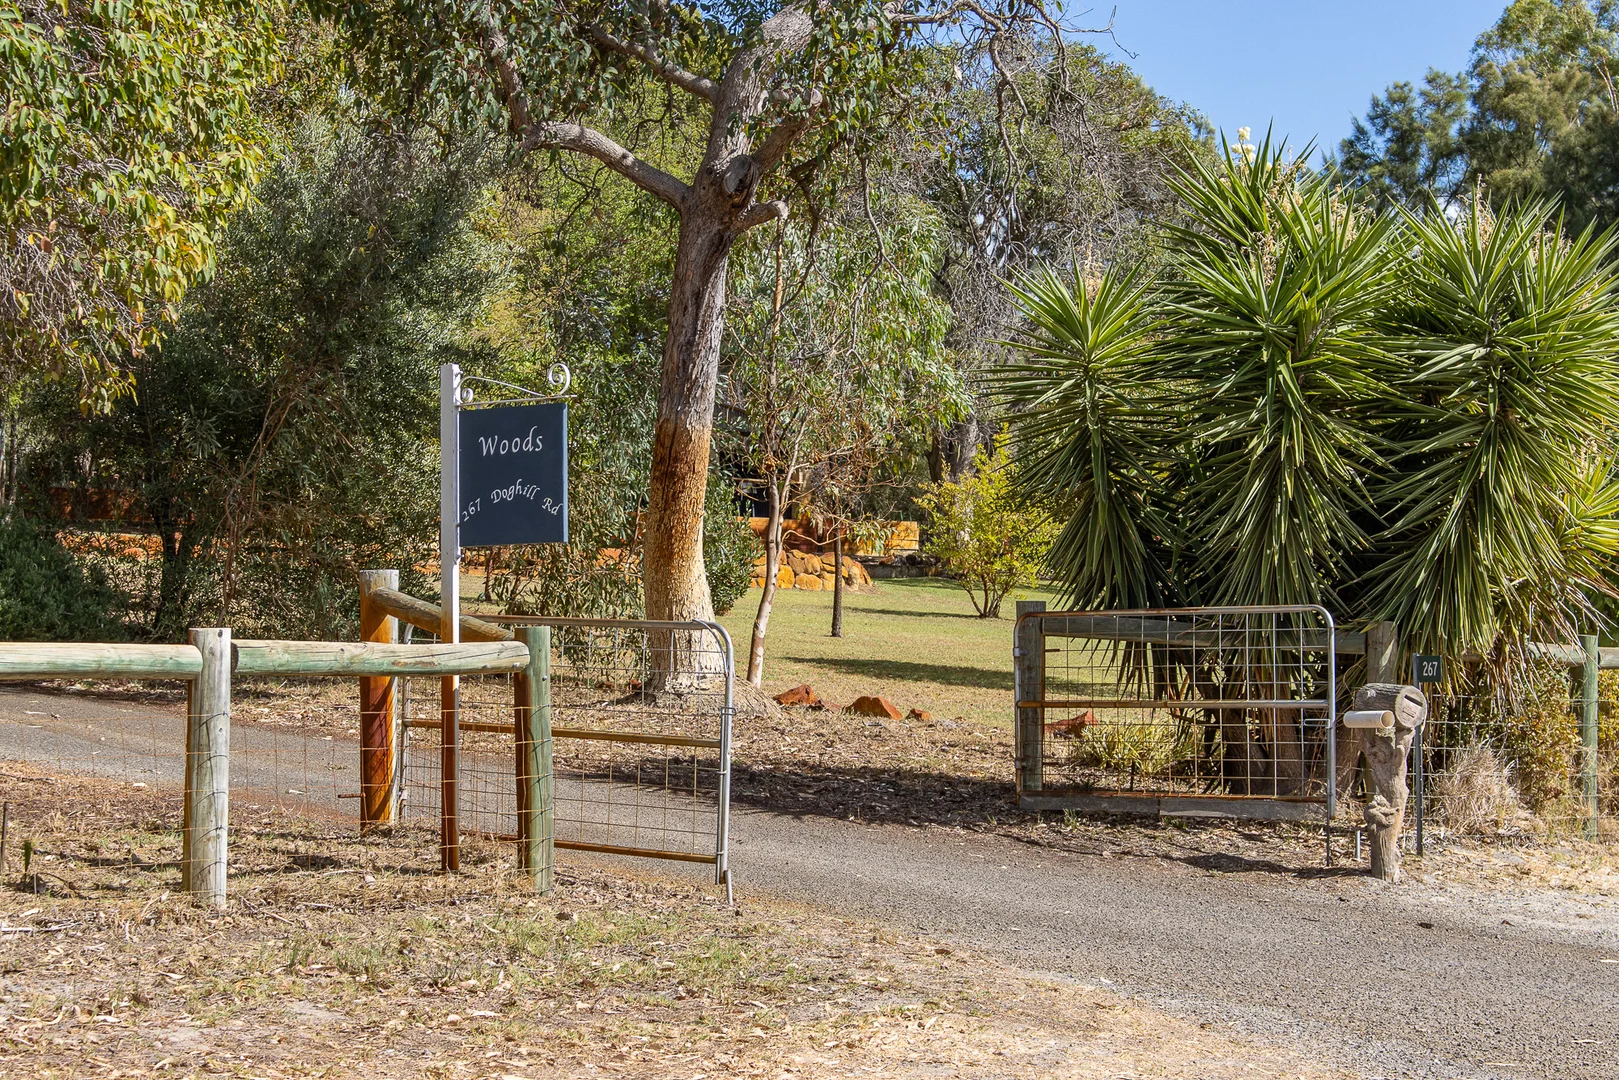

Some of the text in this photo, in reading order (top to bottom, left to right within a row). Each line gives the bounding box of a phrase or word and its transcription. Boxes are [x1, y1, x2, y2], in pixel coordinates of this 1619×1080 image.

[478, 425, 543, 457] Woods
[461, 478, 564, 522] 267 Doghill Rd
[1422, 661, 1438, 676] 267
